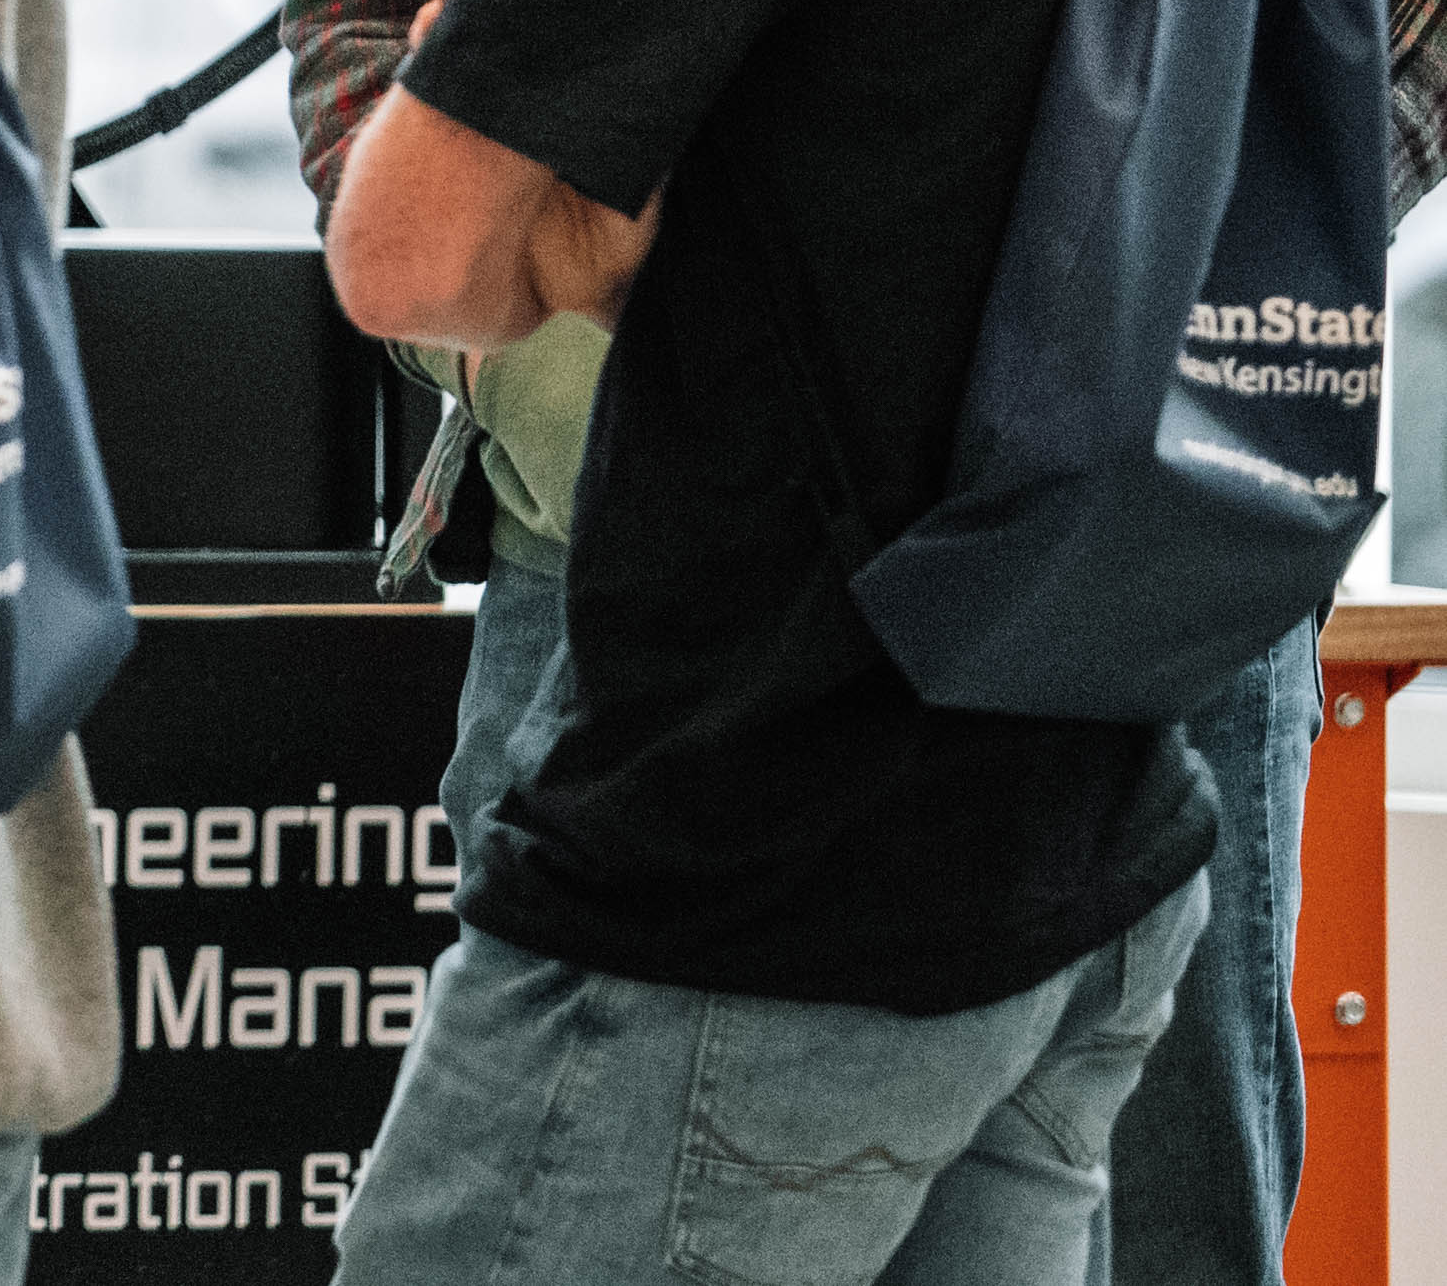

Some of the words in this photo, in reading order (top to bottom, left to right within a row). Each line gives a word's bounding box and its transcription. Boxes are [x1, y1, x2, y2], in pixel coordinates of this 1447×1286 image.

[88, 783, 460, 912] neering
[136, 945, 428, 1050] Mana
[29, 1151, 282, 1232] tration
